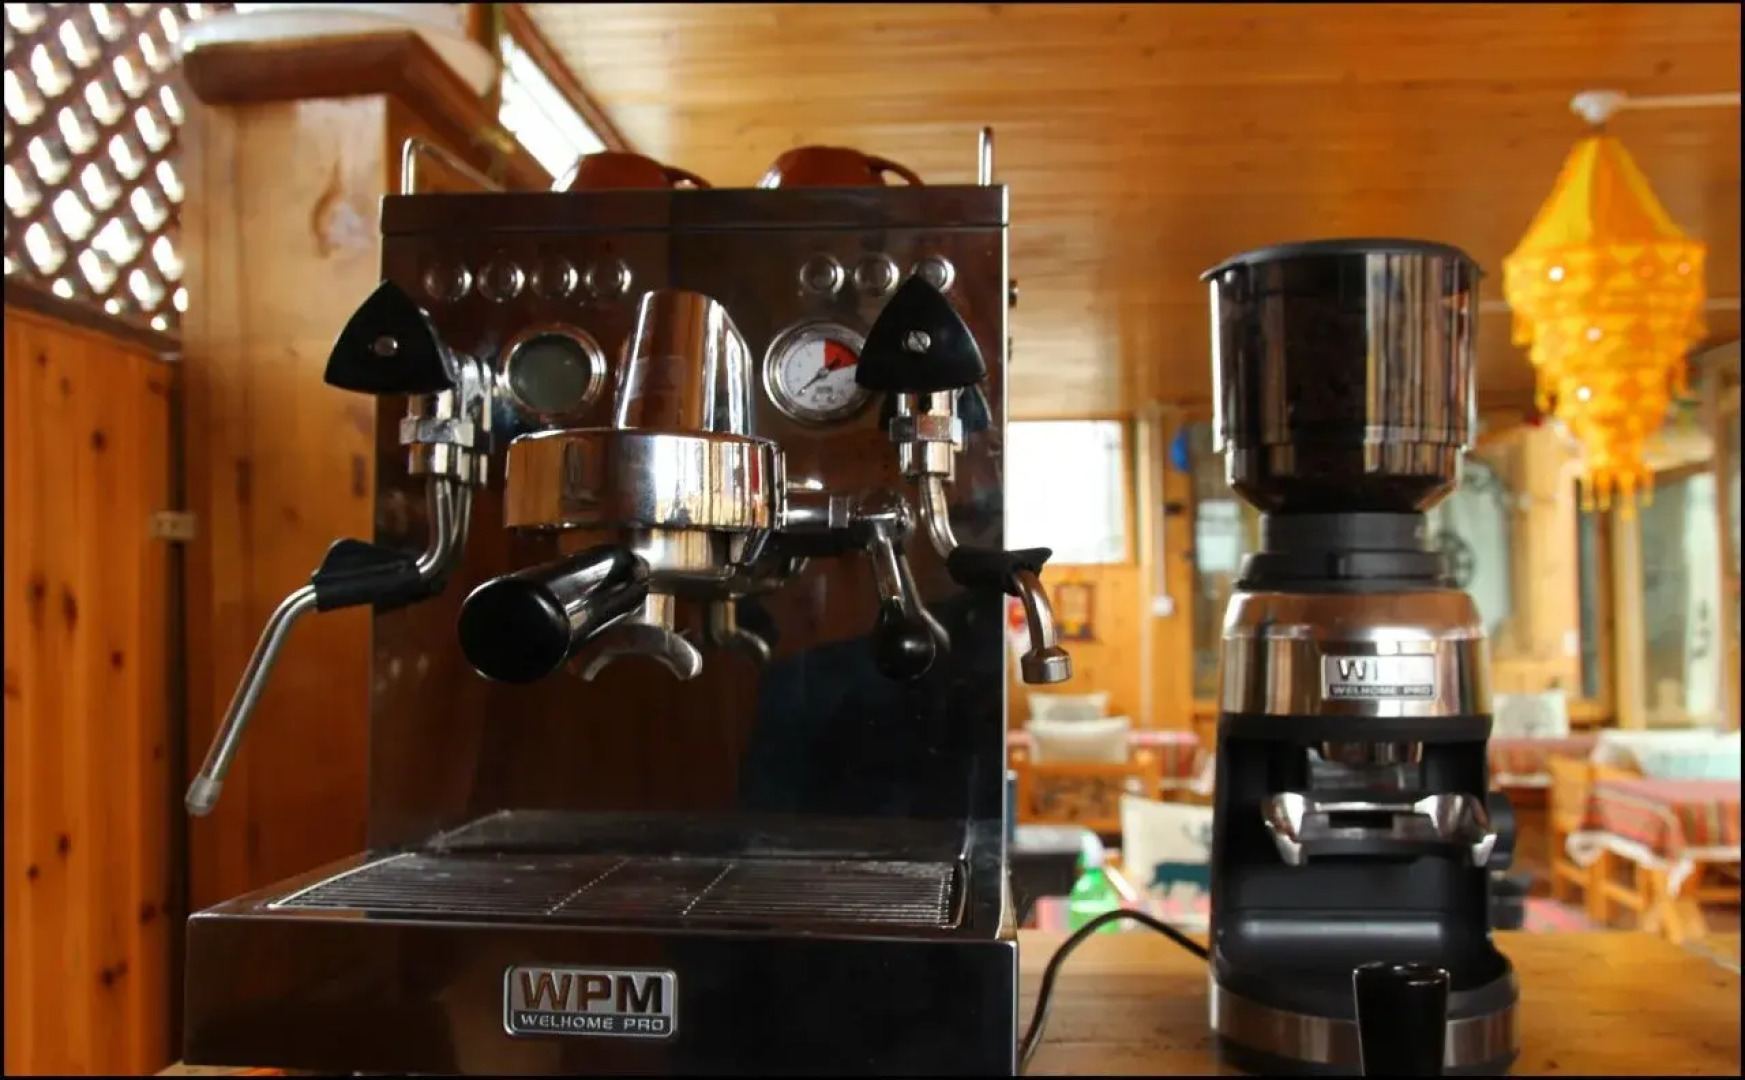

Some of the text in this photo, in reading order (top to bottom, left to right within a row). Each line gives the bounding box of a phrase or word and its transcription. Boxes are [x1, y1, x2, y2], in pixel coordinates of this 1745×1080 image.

[519, 970, 663, 1013] WPM
[521, 1014, 664, 1031] WELHOME PRO
